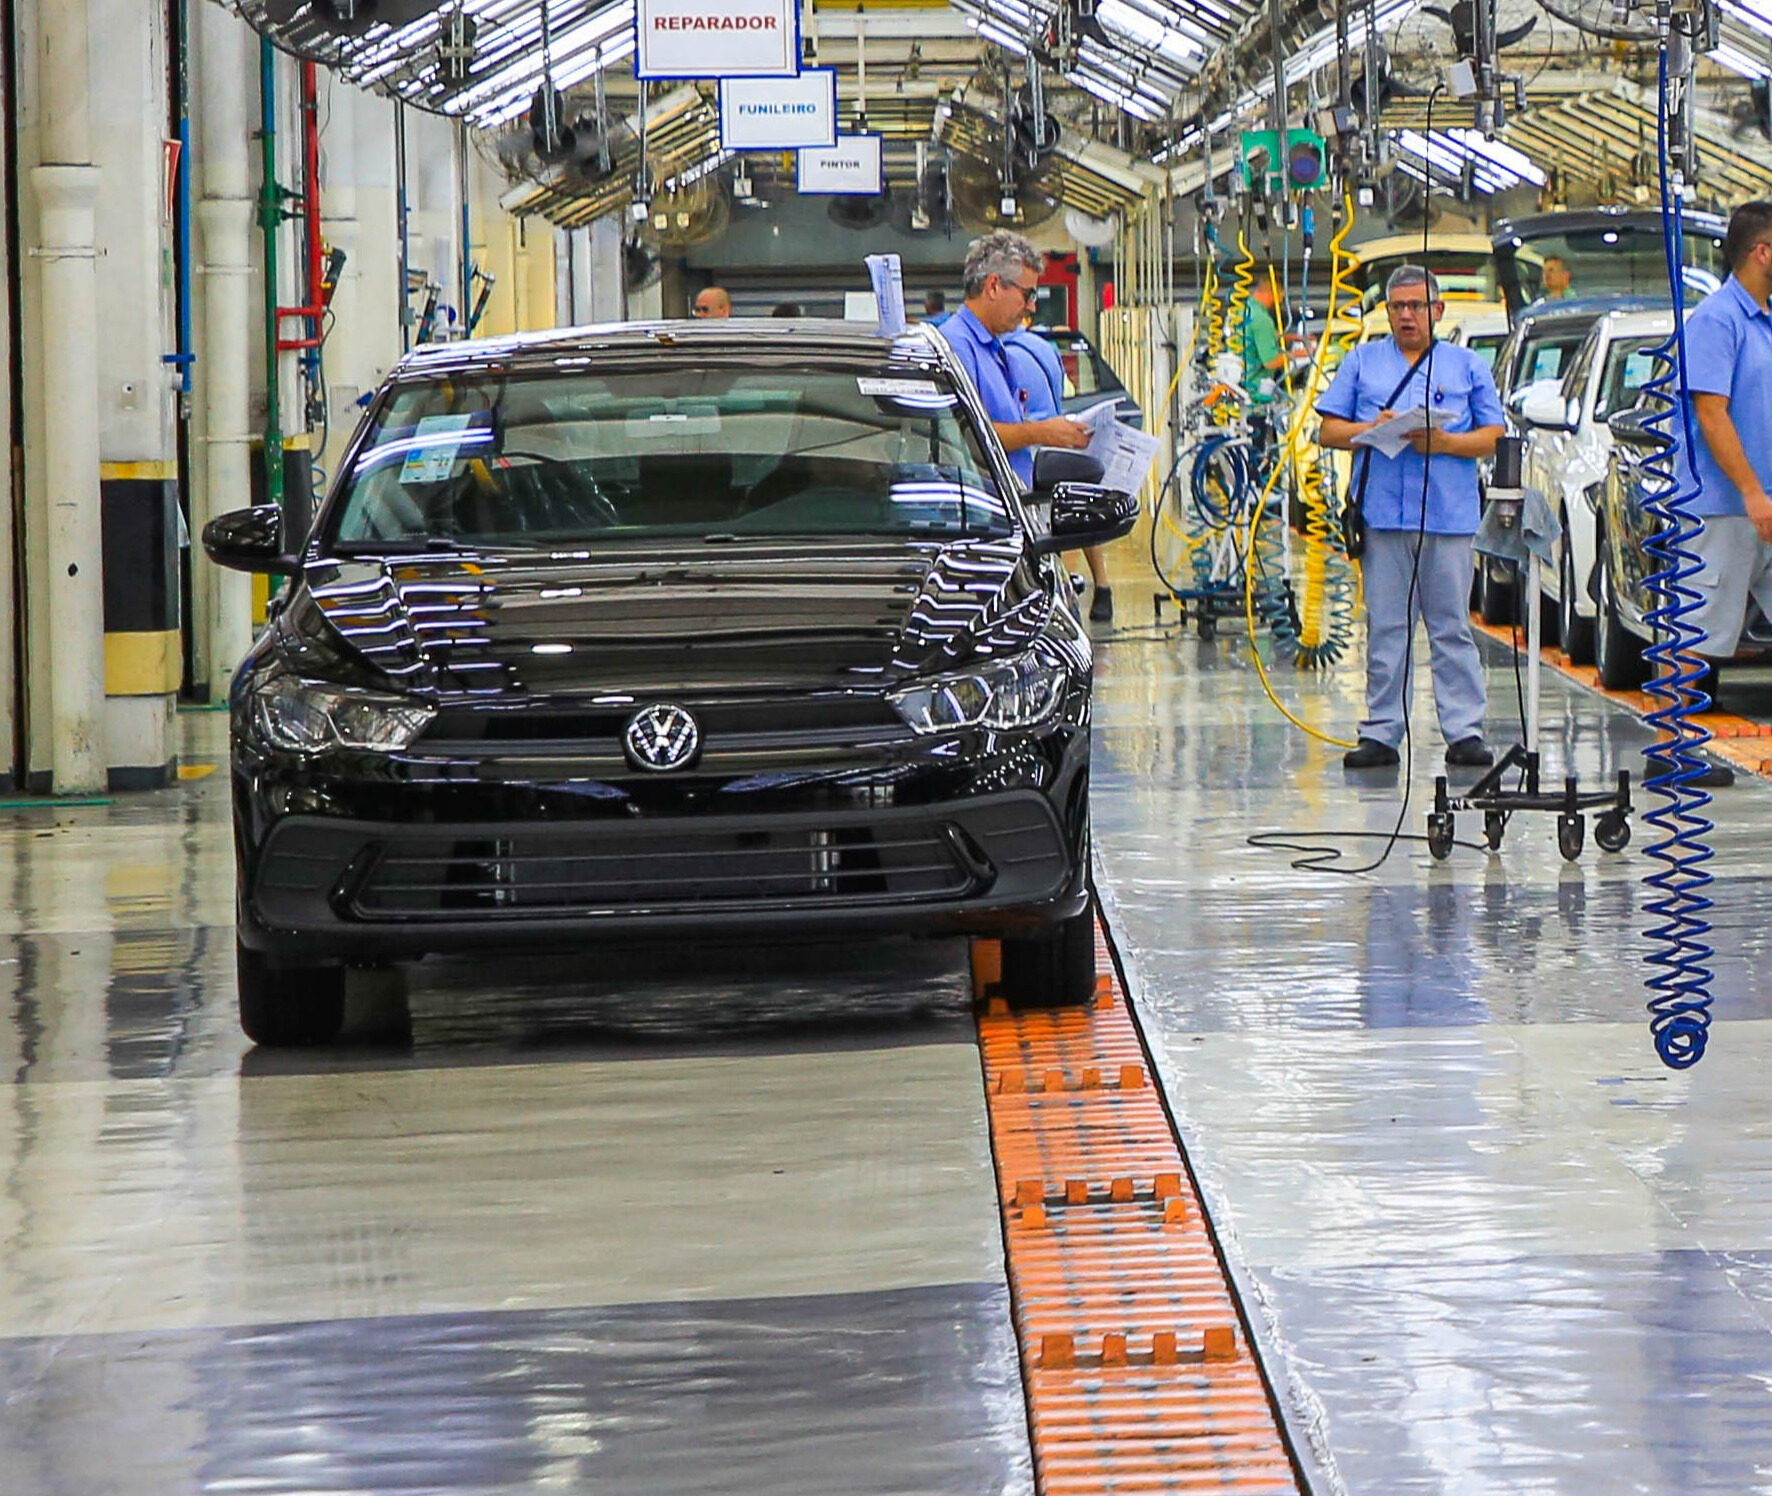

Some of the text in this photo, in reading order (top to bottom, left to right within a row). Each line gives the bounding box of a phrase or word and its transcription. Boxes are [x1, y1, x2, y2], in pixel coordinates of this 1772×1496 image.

[654, 16, 778, 31] REPARADOR
[738, 103, 817, 116] FUNILEIRO
[820, 159, 861, 170] PINTOR
